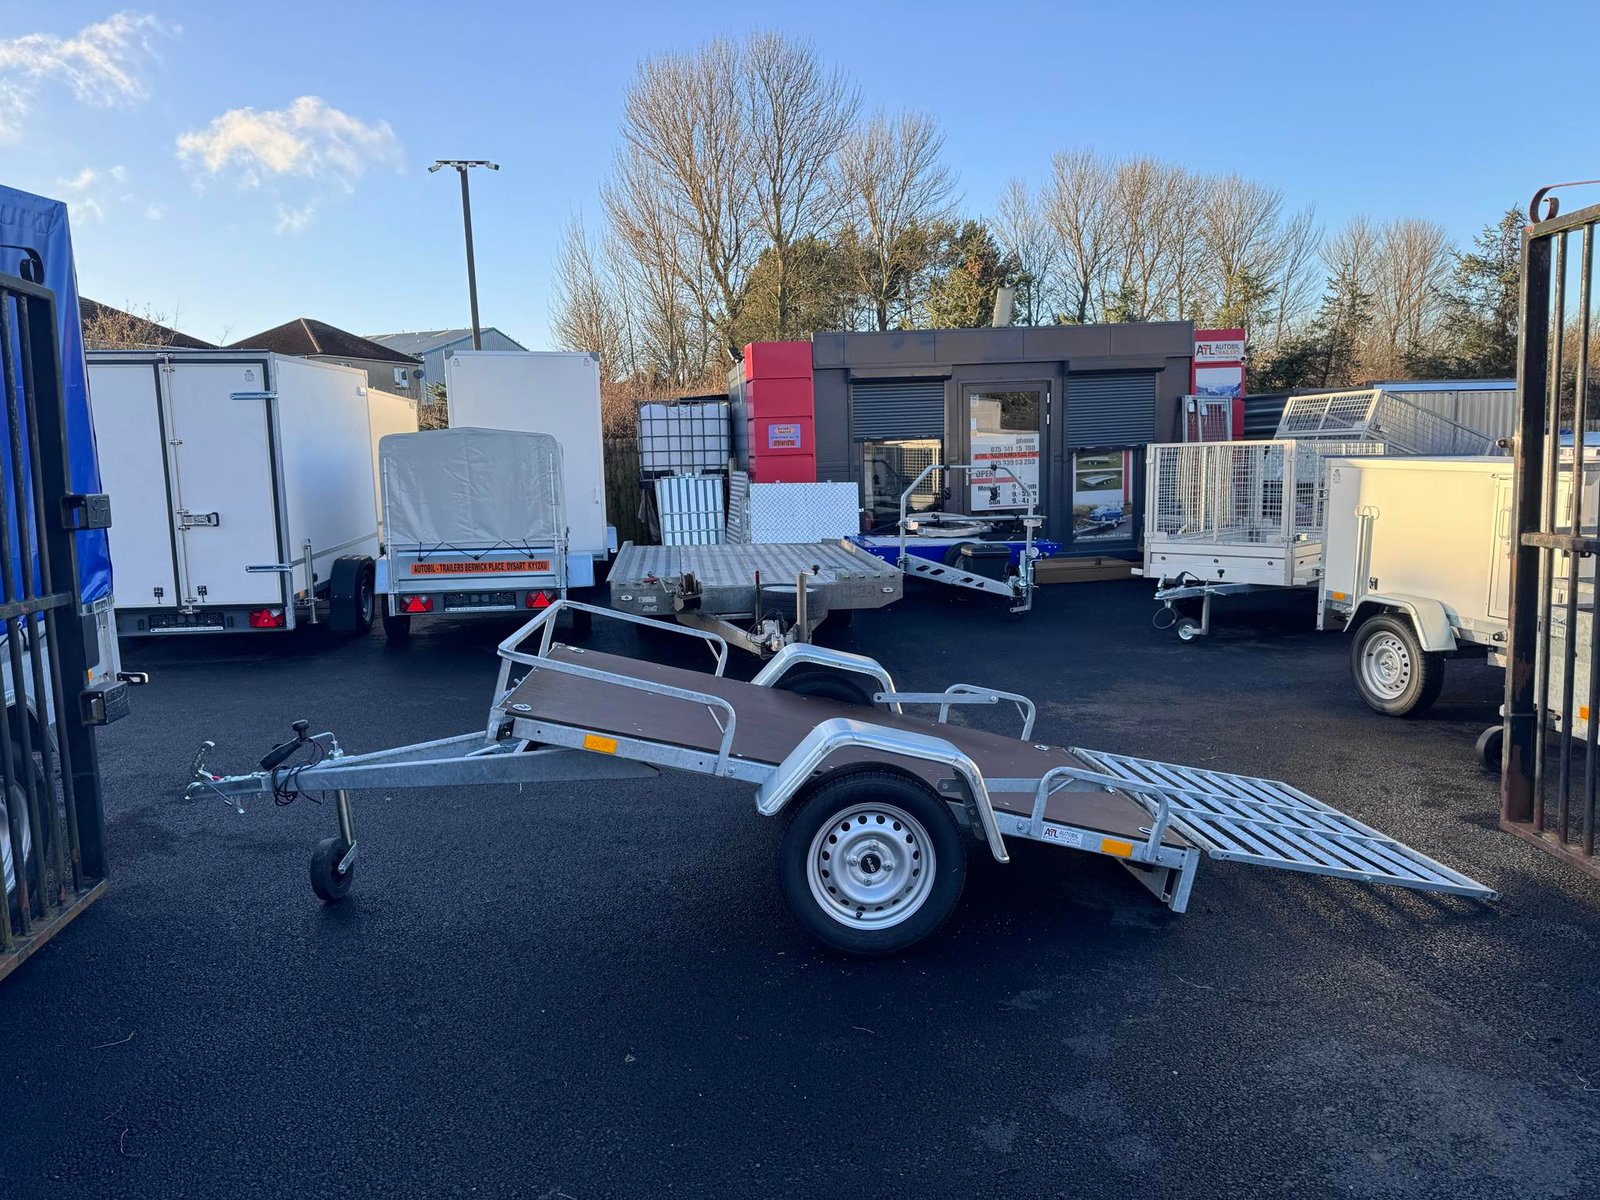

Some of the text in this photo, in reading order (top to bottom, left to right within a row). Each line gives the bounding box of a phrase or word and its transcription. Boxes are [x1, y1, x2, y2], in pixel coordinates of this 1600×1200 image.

[1196, 344, 1215, 355] ATL
[414, 564, 435, 573] AUTOBIL
[440, 563, 464, 572] TRAILERS
[465, 562, 487, 572] BERWICK
